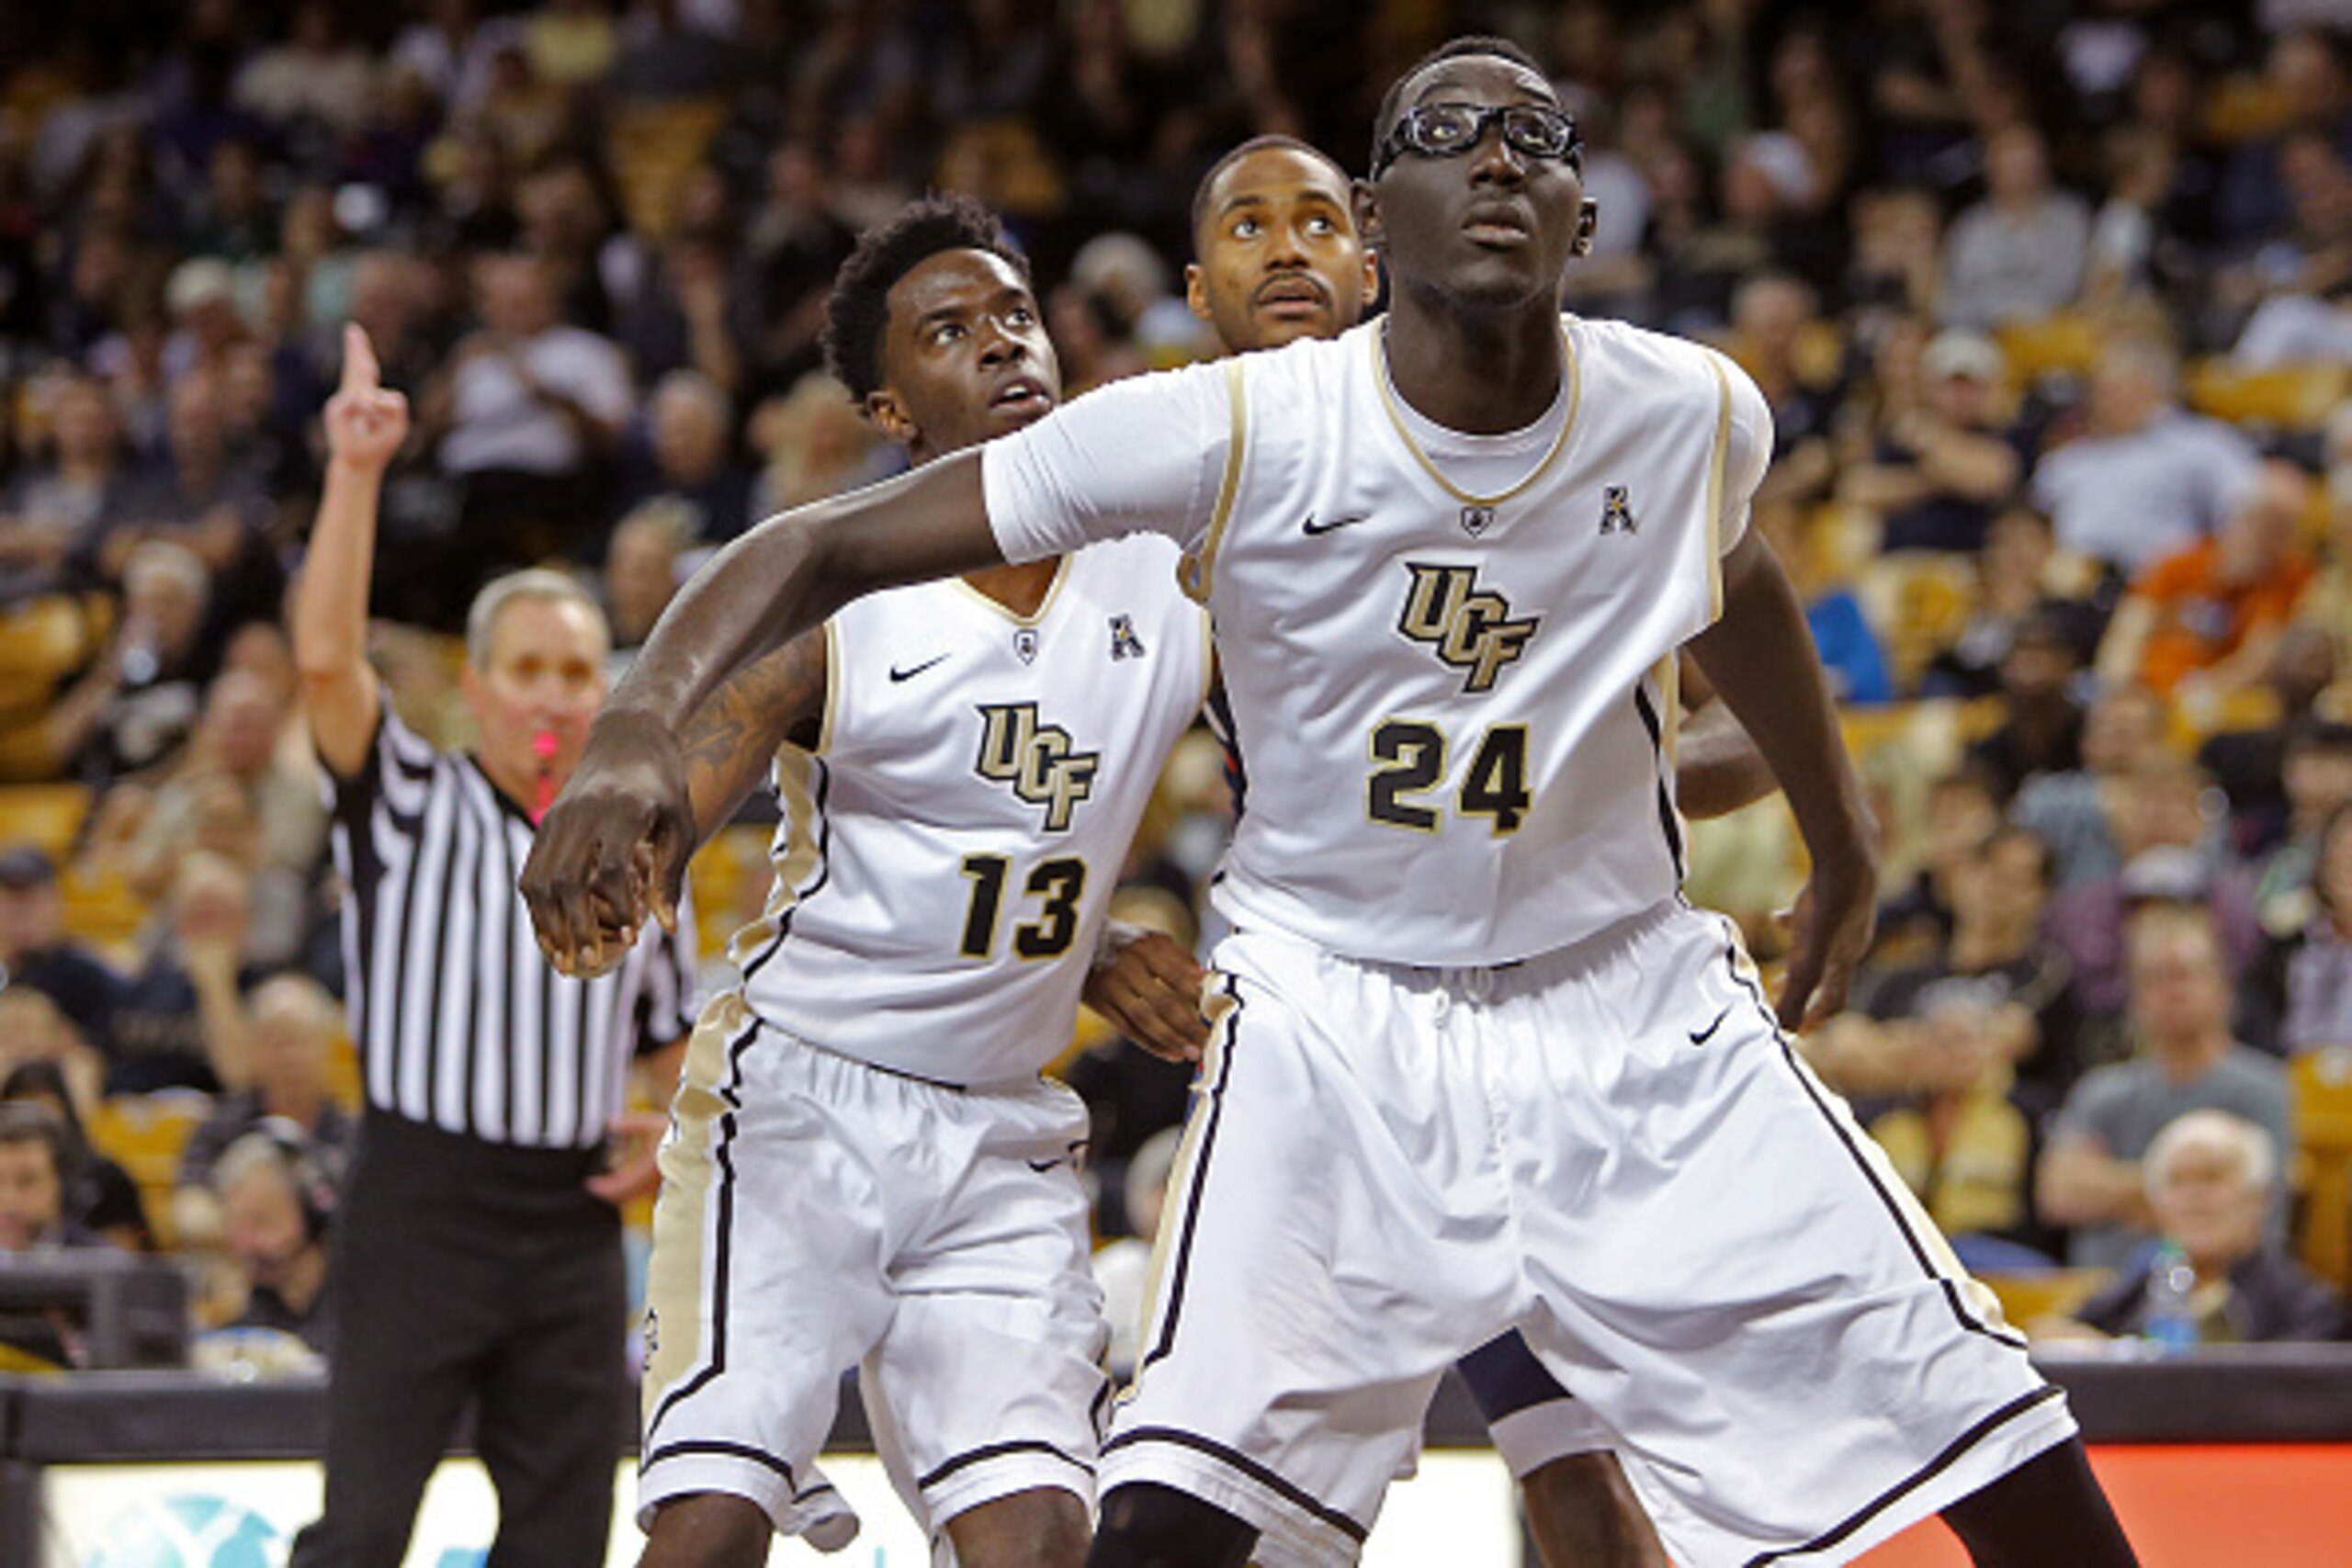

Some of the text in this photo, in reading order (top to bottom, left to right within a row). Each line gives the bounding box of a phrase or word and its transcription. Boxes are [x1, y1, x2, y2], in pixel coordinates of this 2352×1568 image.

[1397, 561, 1541, 694] UCF
[975, 701, 1100, 832] UCF
[1365, 716, 1532, 837] 24
[959, 852, 1088, 962] 13
